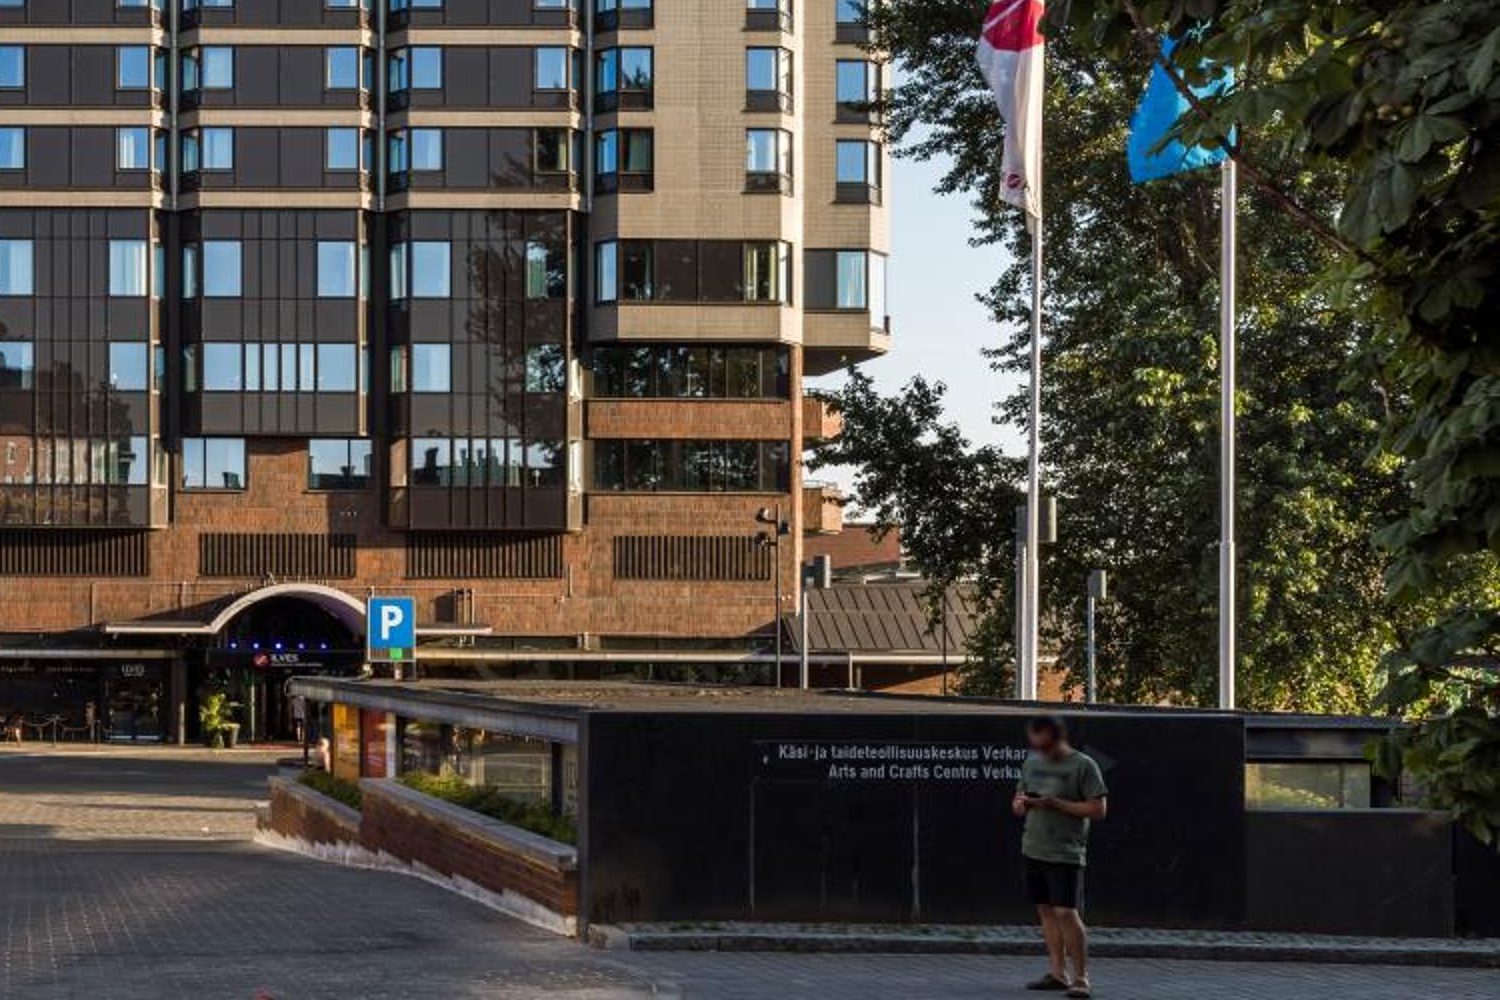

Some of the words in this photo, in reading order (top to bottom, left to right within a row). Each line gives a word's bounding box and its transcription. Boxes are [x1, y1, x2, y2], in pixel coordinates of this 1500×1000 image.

[380, 604, 404, 640] P
[982, 745, 1027, 760] Verkar
[828, 763, 857, 778] Arts
[860, 764, 885, 778] and
[889, 764, 930, 778] Crafts
[933, 764, 978, 778] Centre
